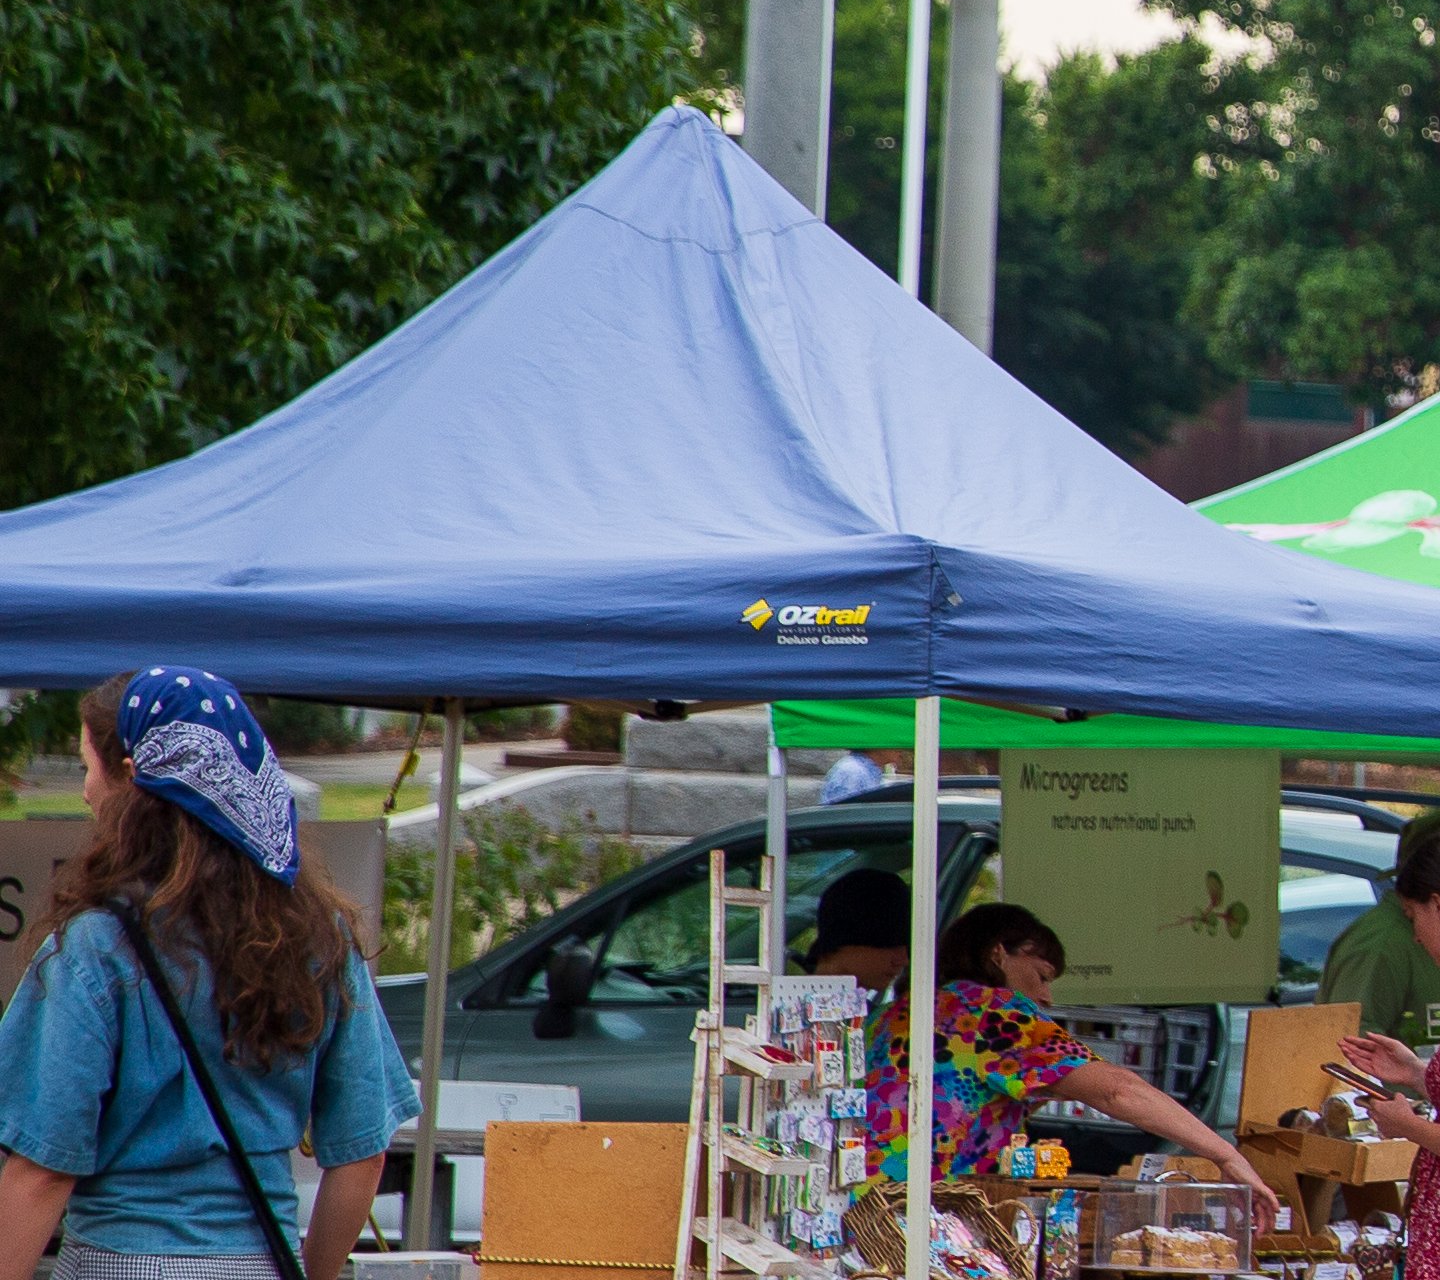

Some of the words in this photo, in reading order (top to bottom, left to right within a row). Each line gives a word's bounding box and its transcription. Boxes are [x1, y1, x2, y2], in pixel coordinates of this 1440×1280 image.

[777, 634, 820, 645] Deluxe
[821, 634, 869, 645] Gazebo
[1019, 763, 1129, 801] Microgreens
